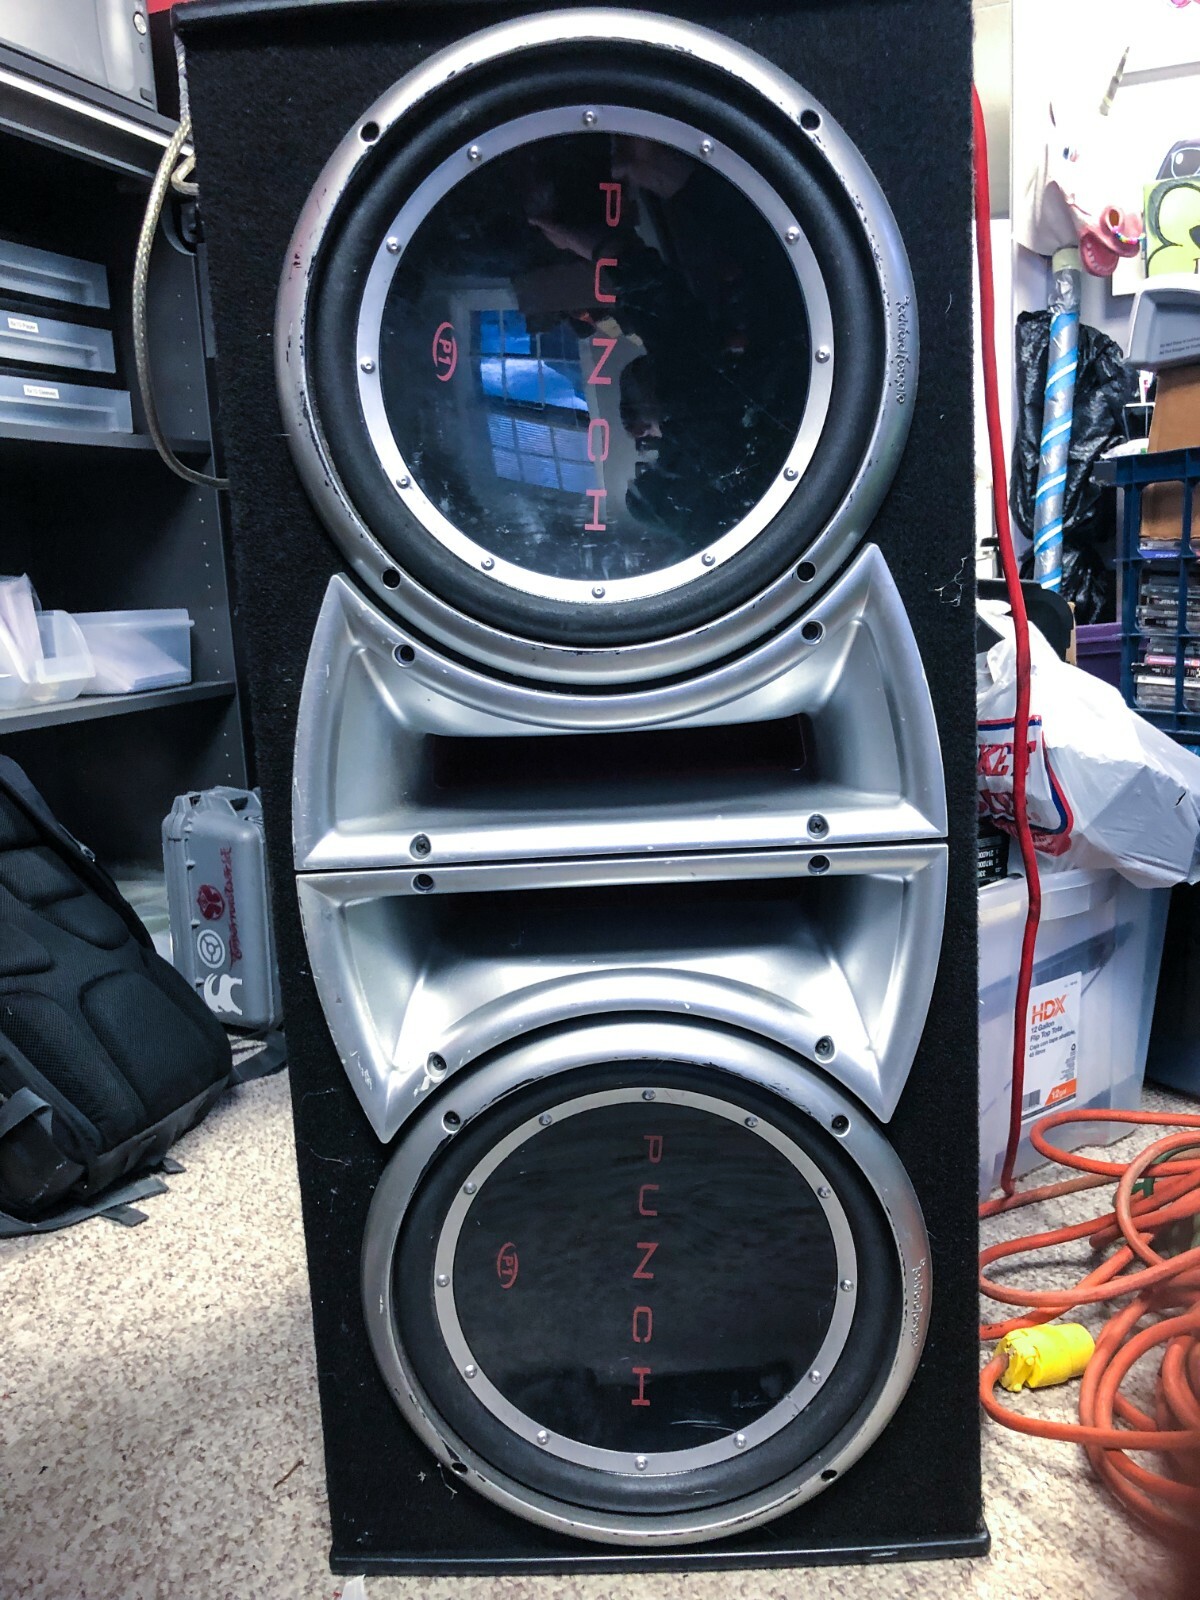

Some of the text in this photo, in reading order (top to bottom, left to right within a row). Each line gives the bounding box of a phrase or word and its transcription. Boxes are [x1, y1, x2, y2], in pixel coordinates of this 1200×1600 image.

[584, 182, 621, 532] PUNCH
[1031, 994, 1067, 1025] HDX
[1031, 1021, 1055, 1034] 12 Gallon
[631, 1135, 664, 1406] PUNCH
